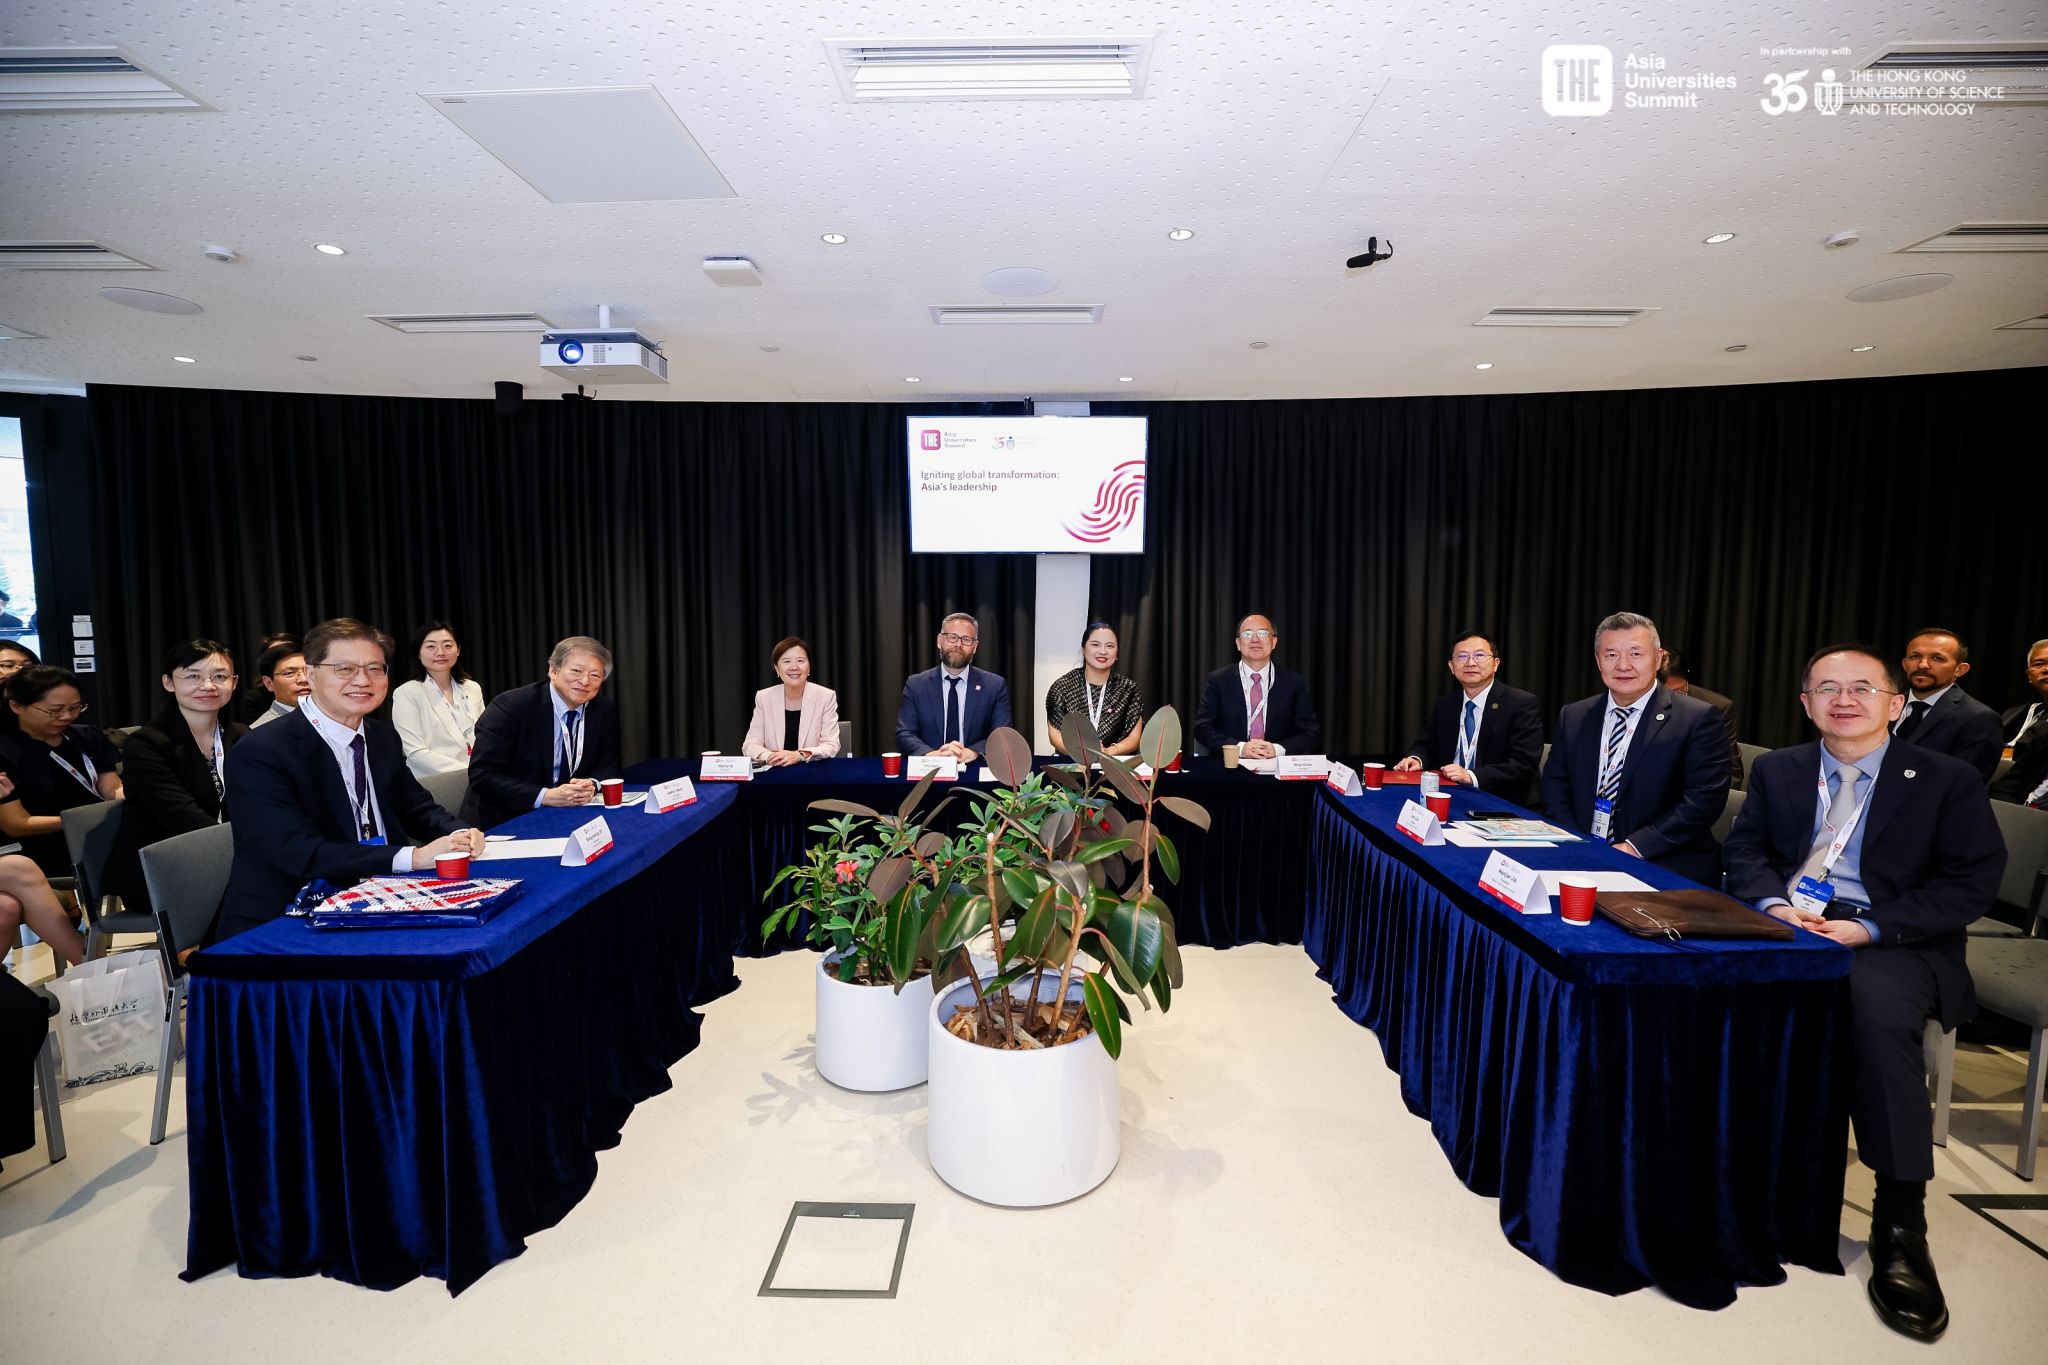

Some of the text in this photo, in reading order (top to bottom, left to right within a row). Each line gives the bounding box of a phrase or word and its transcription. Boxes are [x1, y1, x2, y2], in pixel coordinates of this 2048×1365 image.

[924, 433, 938, 447] THE
[921, 470, 1060, 481] Igniting global transformation:
[921, 482, 997, 493] Asia's leadership
